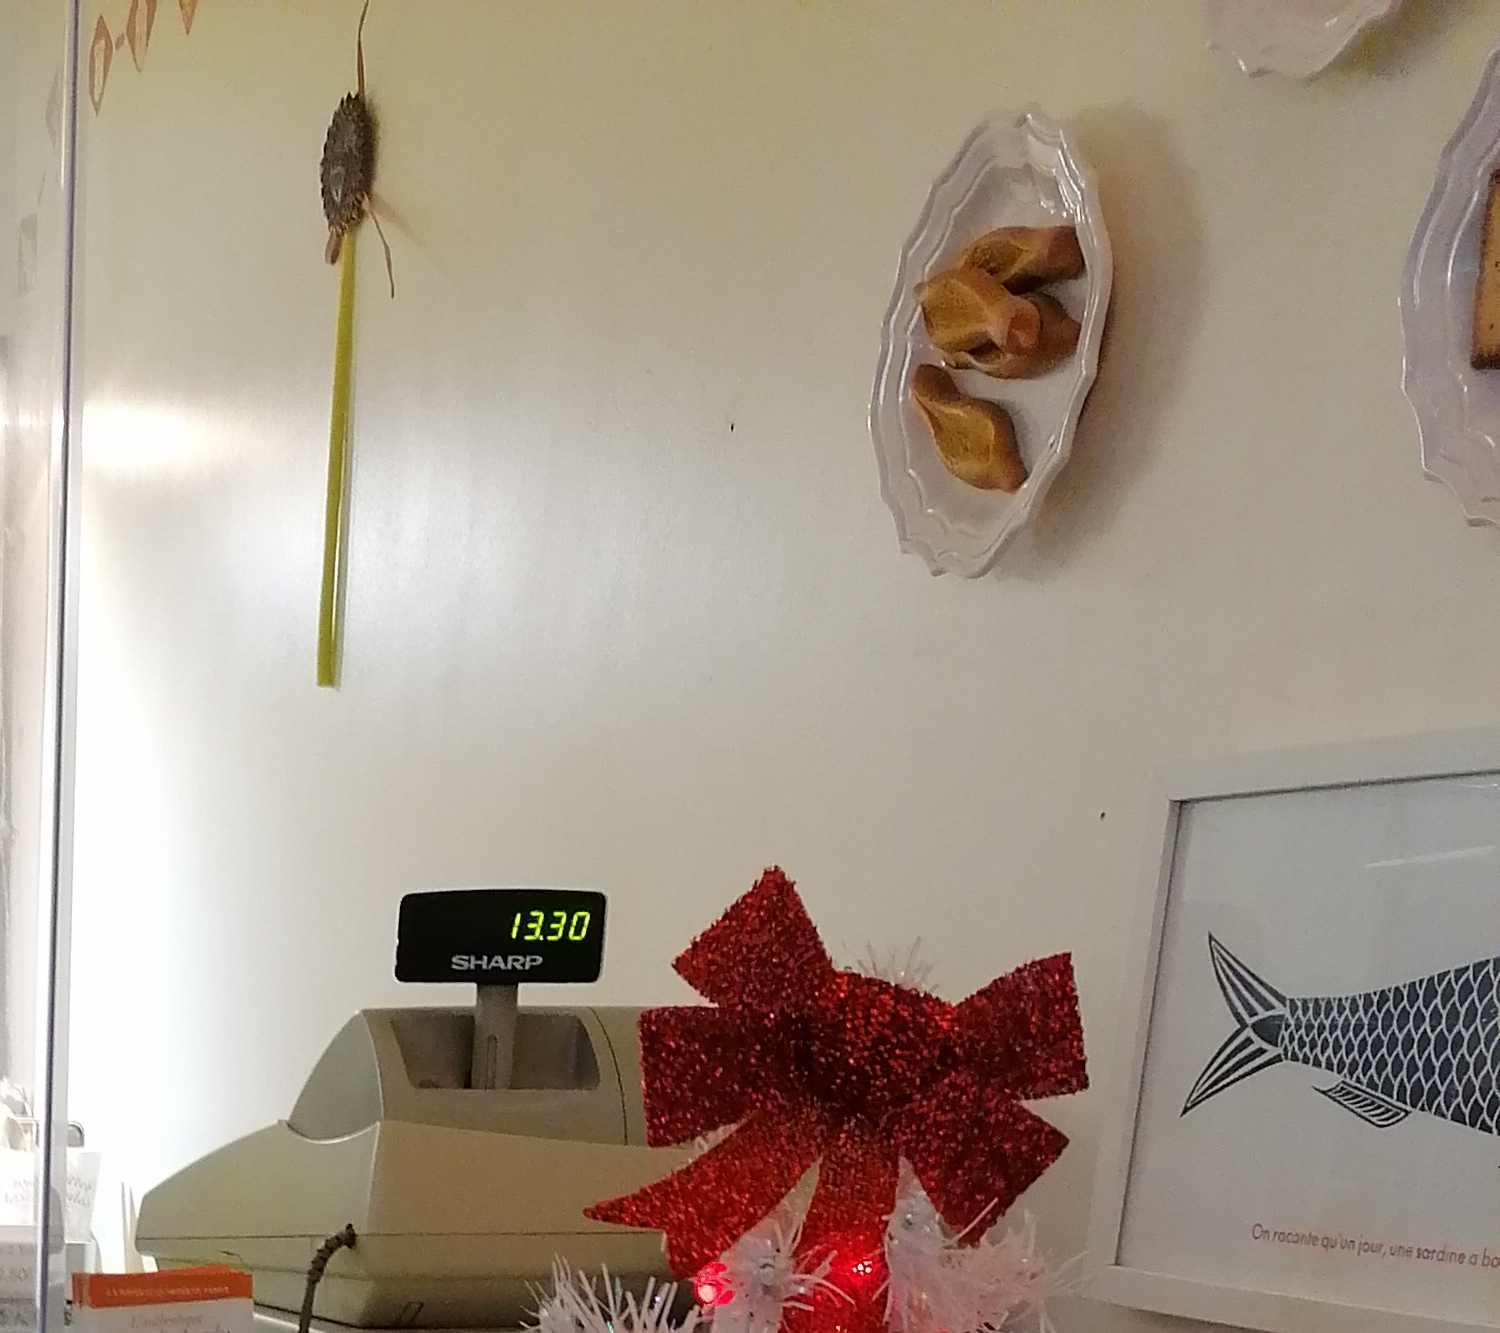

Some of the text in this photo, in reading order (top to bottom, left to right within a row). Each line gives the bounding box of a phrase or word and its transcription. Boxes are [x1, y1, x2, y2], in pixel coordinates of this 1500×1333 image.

[510, 910, 591, 941] 13.30
[450, 954, 543, 971] SHARP
[1251, 1223, 1270, 1241] On
[1273, 1231, 1320, 1248] raconte
[1321, 1233, 1356, 1252] qu'un
[1357, 1236, 1387, 1259] jour,
[1389, 1244, 1414, 1258] une
[1415, 1244, 1466, 1266] sardine
[1468, 1254, 1478, 1267] a
